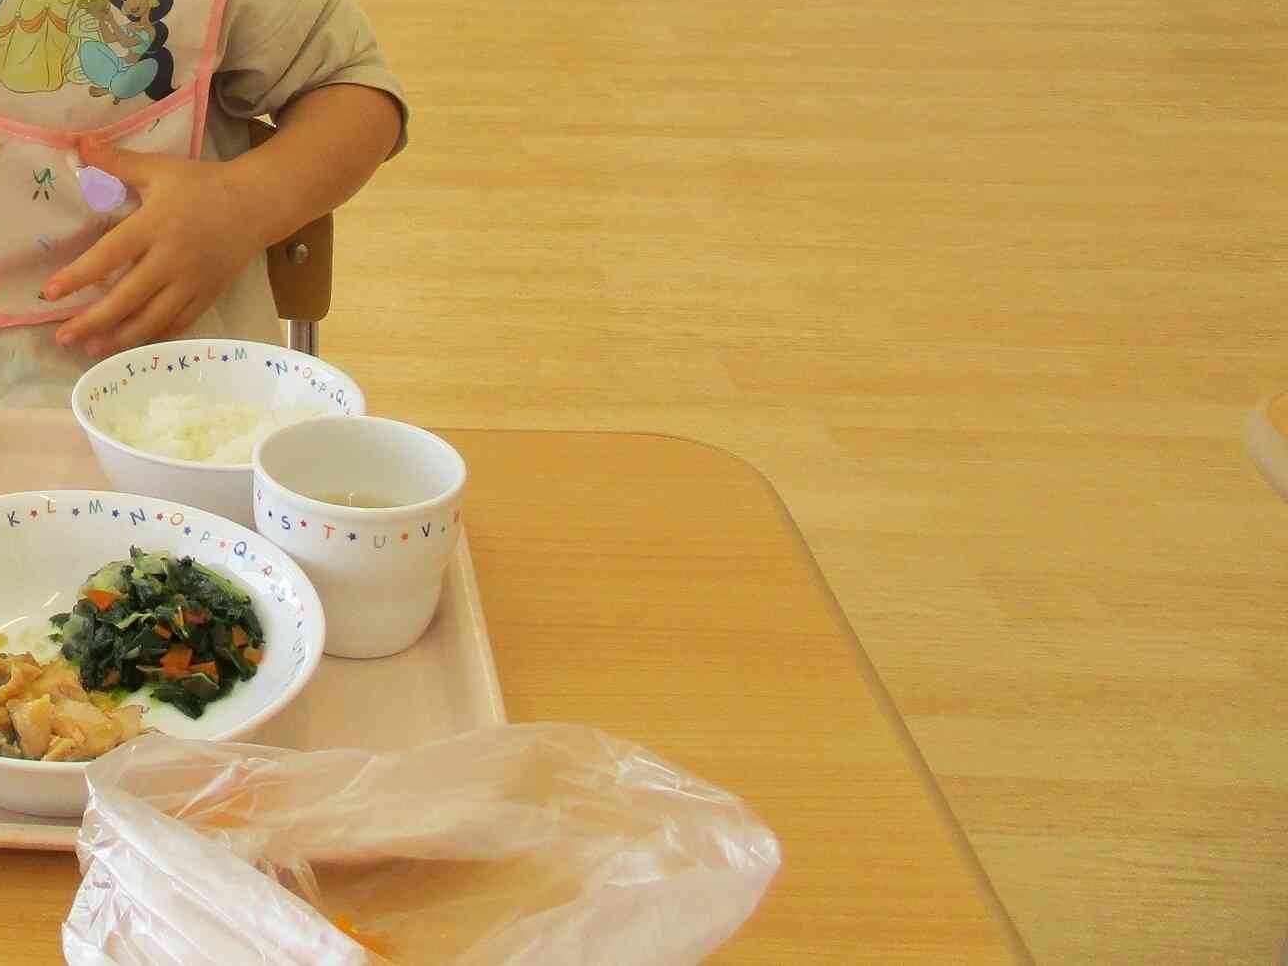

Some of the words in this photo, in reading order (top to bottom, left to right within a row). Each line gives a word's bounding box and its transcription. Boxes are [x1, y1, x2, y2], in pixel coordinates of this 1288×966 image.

[178, 355, 190, 370] K
[207, 345, 217, 360] L
[234, 346, 248, 361] M
[275, 361, 289, 375] N
[7, 510, 21, 528] K
[88, 499, 104, 515] M
[129, 508, 147, 526] N
[170, 512, 184, 526] O
[233, 540, 247, 559] Q
[280, 515, 292, 531] S
[323, 524, 336, 539] T
[373, 534, 387, 549] U
[421, 521, 432, 538] V
